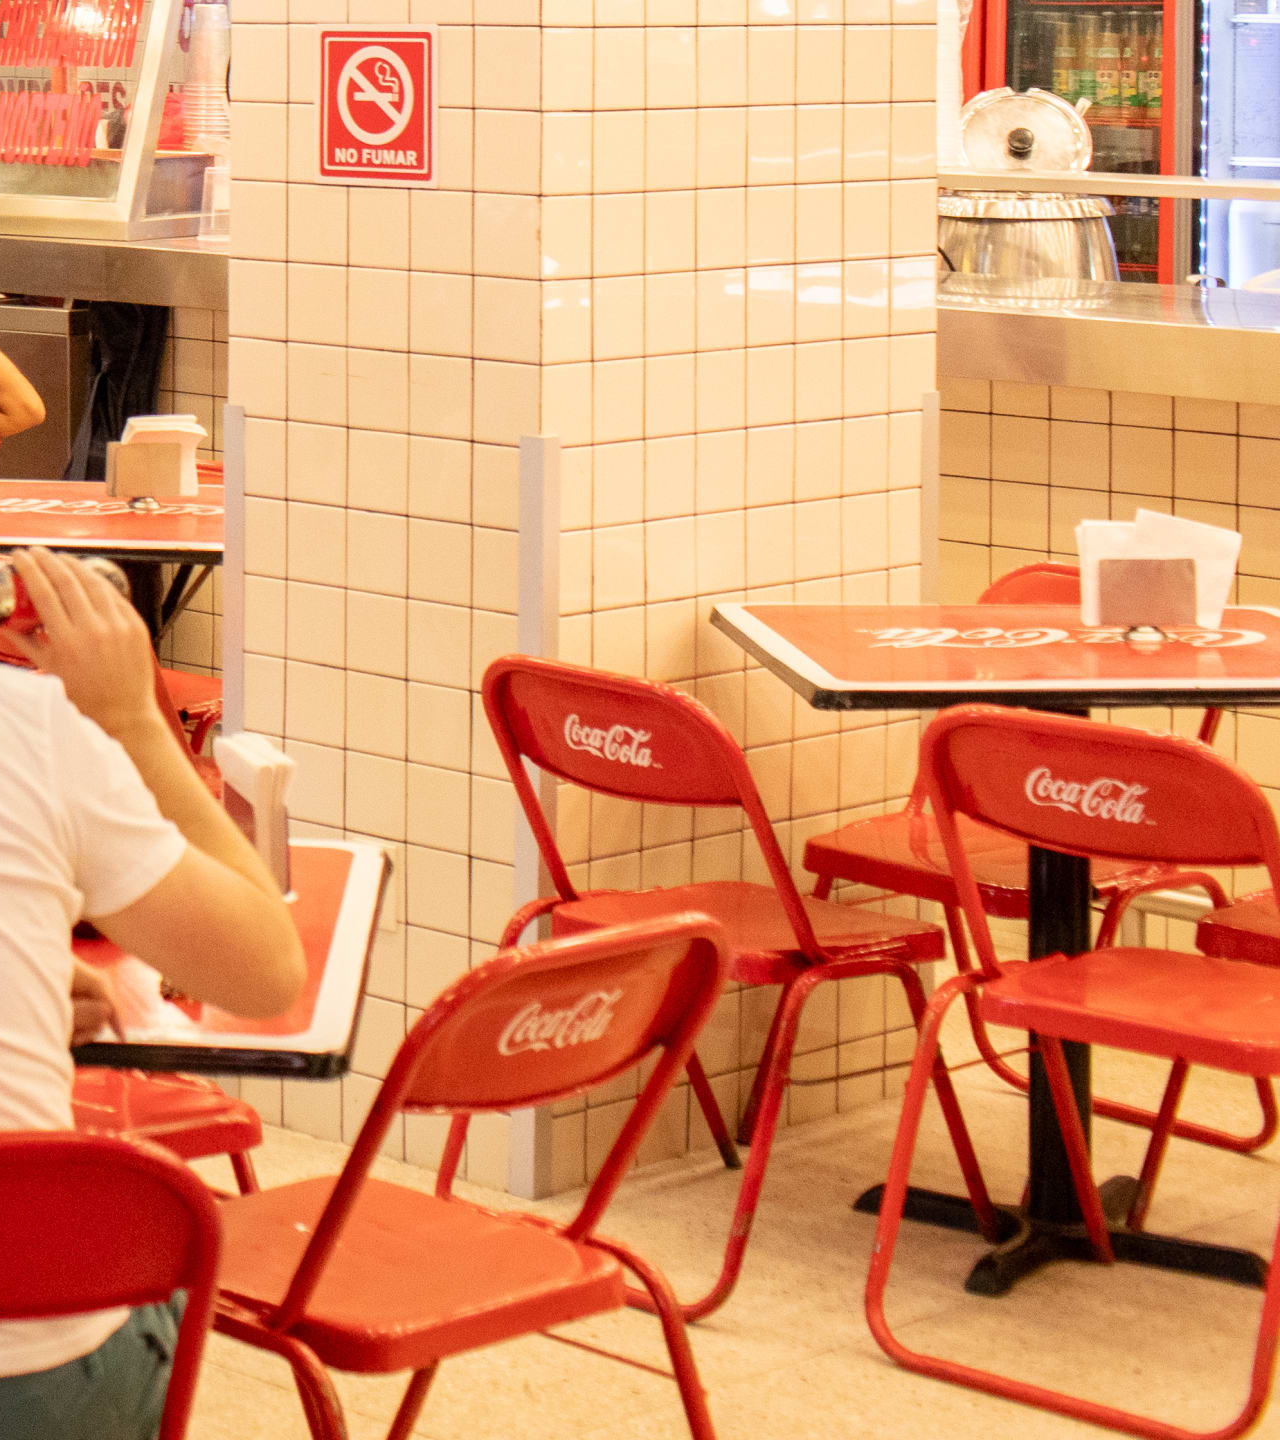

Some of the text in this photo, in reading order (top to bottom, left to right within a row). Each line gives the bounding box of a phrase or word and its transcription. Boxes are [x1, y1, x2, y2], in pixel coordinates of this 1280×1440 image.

[334, 147, 418, 166] NO FUMAR
[563, 713, 654, 768] Coca-Cola
[1024, 766, 1149, 825] Coca-Cola
[497, 989, 624, 1057] Coca-Cola
